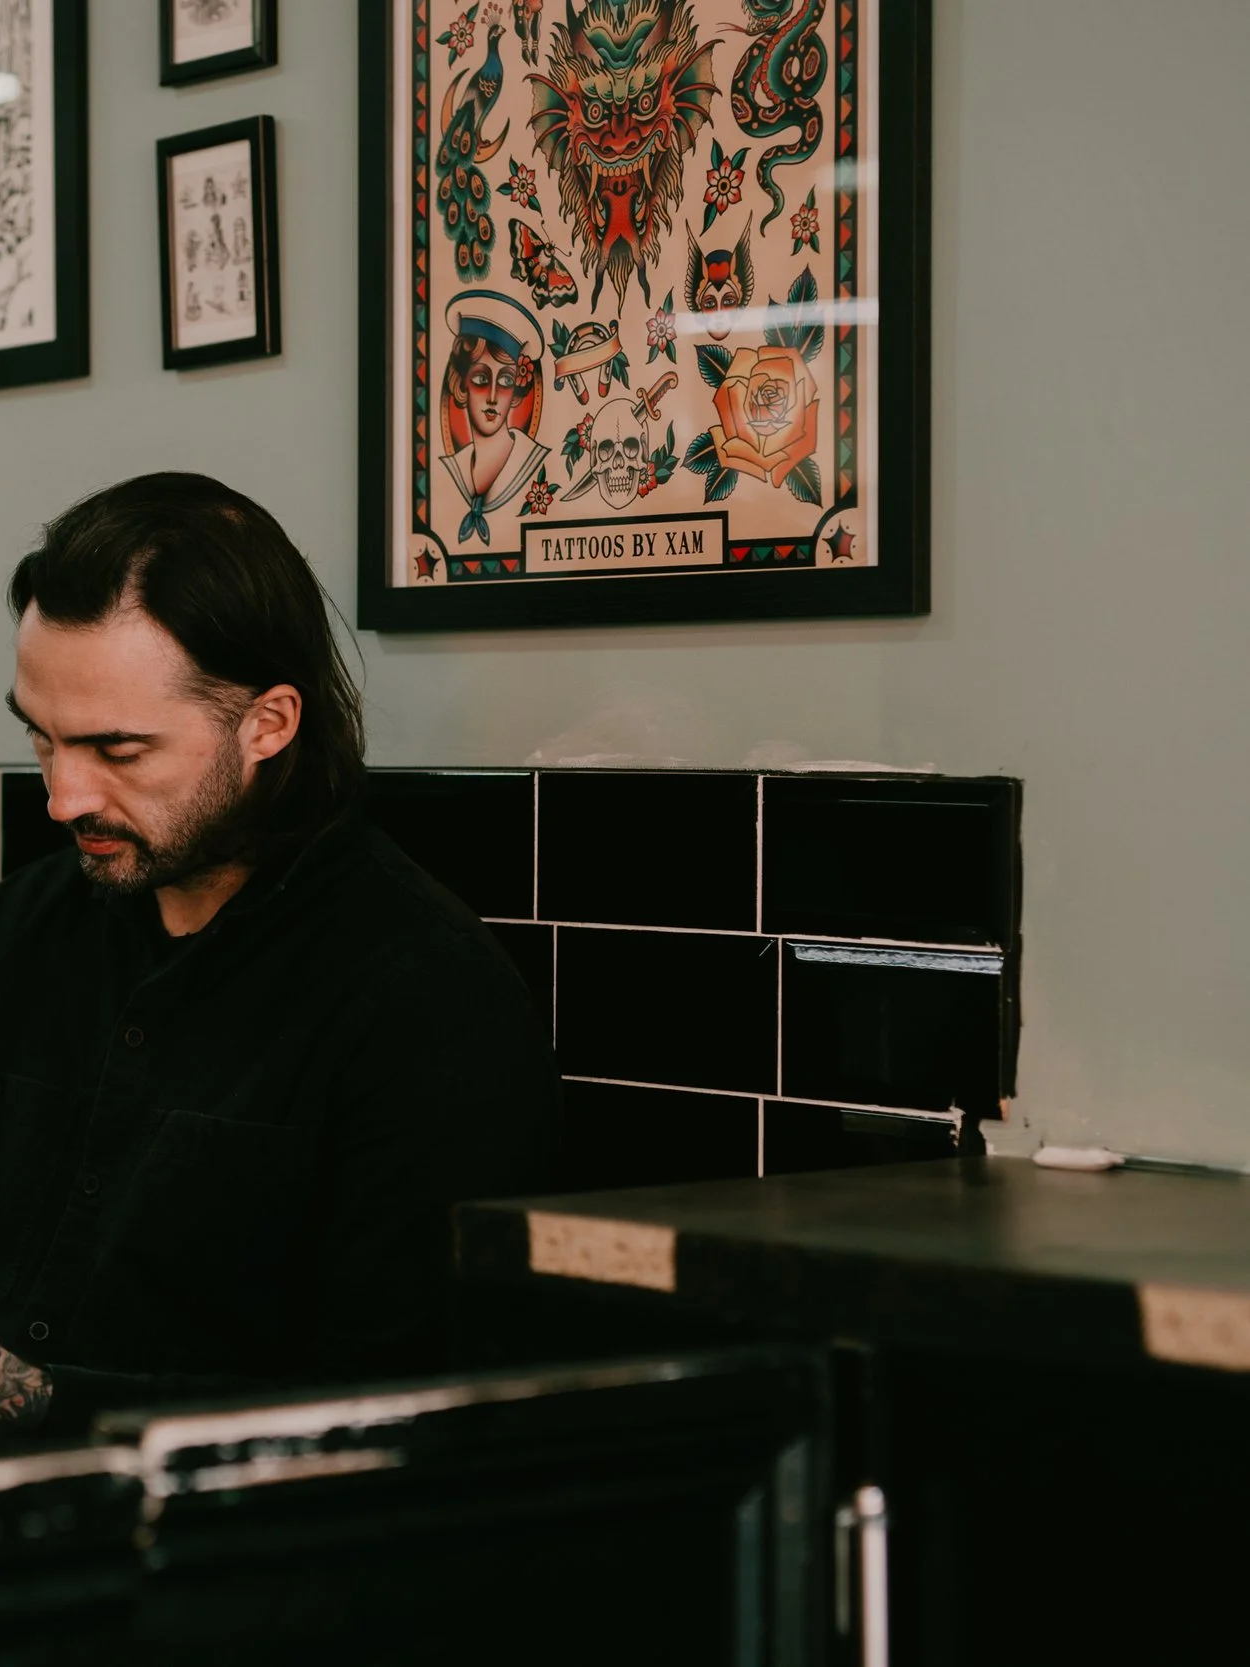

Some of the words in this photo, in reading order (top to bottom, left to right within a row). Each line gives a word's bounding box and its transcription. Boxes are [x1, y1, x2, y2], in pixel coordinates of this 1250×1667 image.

[542, 535, 624, 561] TATTOOS
[632, 533, 657, 557] BY
[665, 530, 704, 555] XAM
